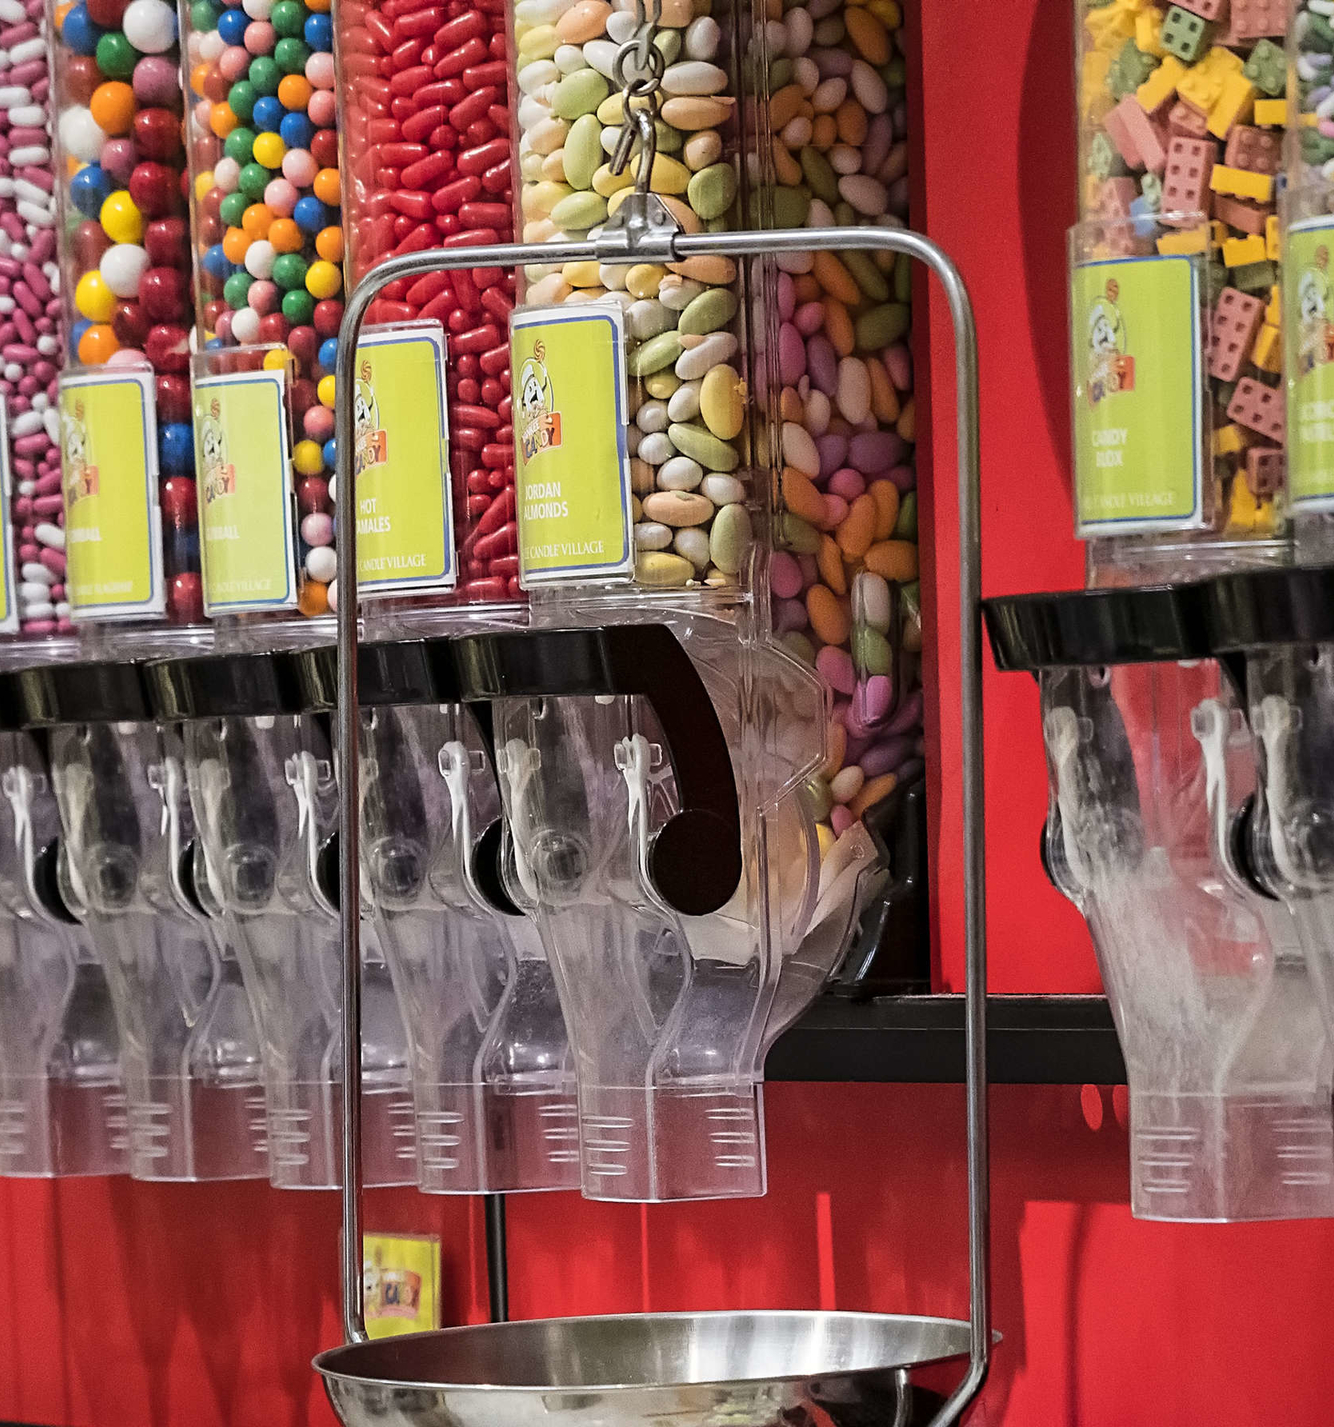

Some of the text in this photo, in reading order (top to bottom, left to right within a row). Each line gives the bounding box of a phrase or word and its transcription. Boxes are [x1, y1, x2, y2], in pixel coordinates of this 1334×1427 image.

[525, 481, 561, 501] JORDAN
[359, 498, 377, 515] HOT
[523, 501, 569, 521] ALMONDS
[356, 516, 391, 535] AMALES
[530, 543, 560, 559] CANDLE
[560, 540, 605, 556] VILLAGE
[386, 553, 426, 569] VILLAGE
